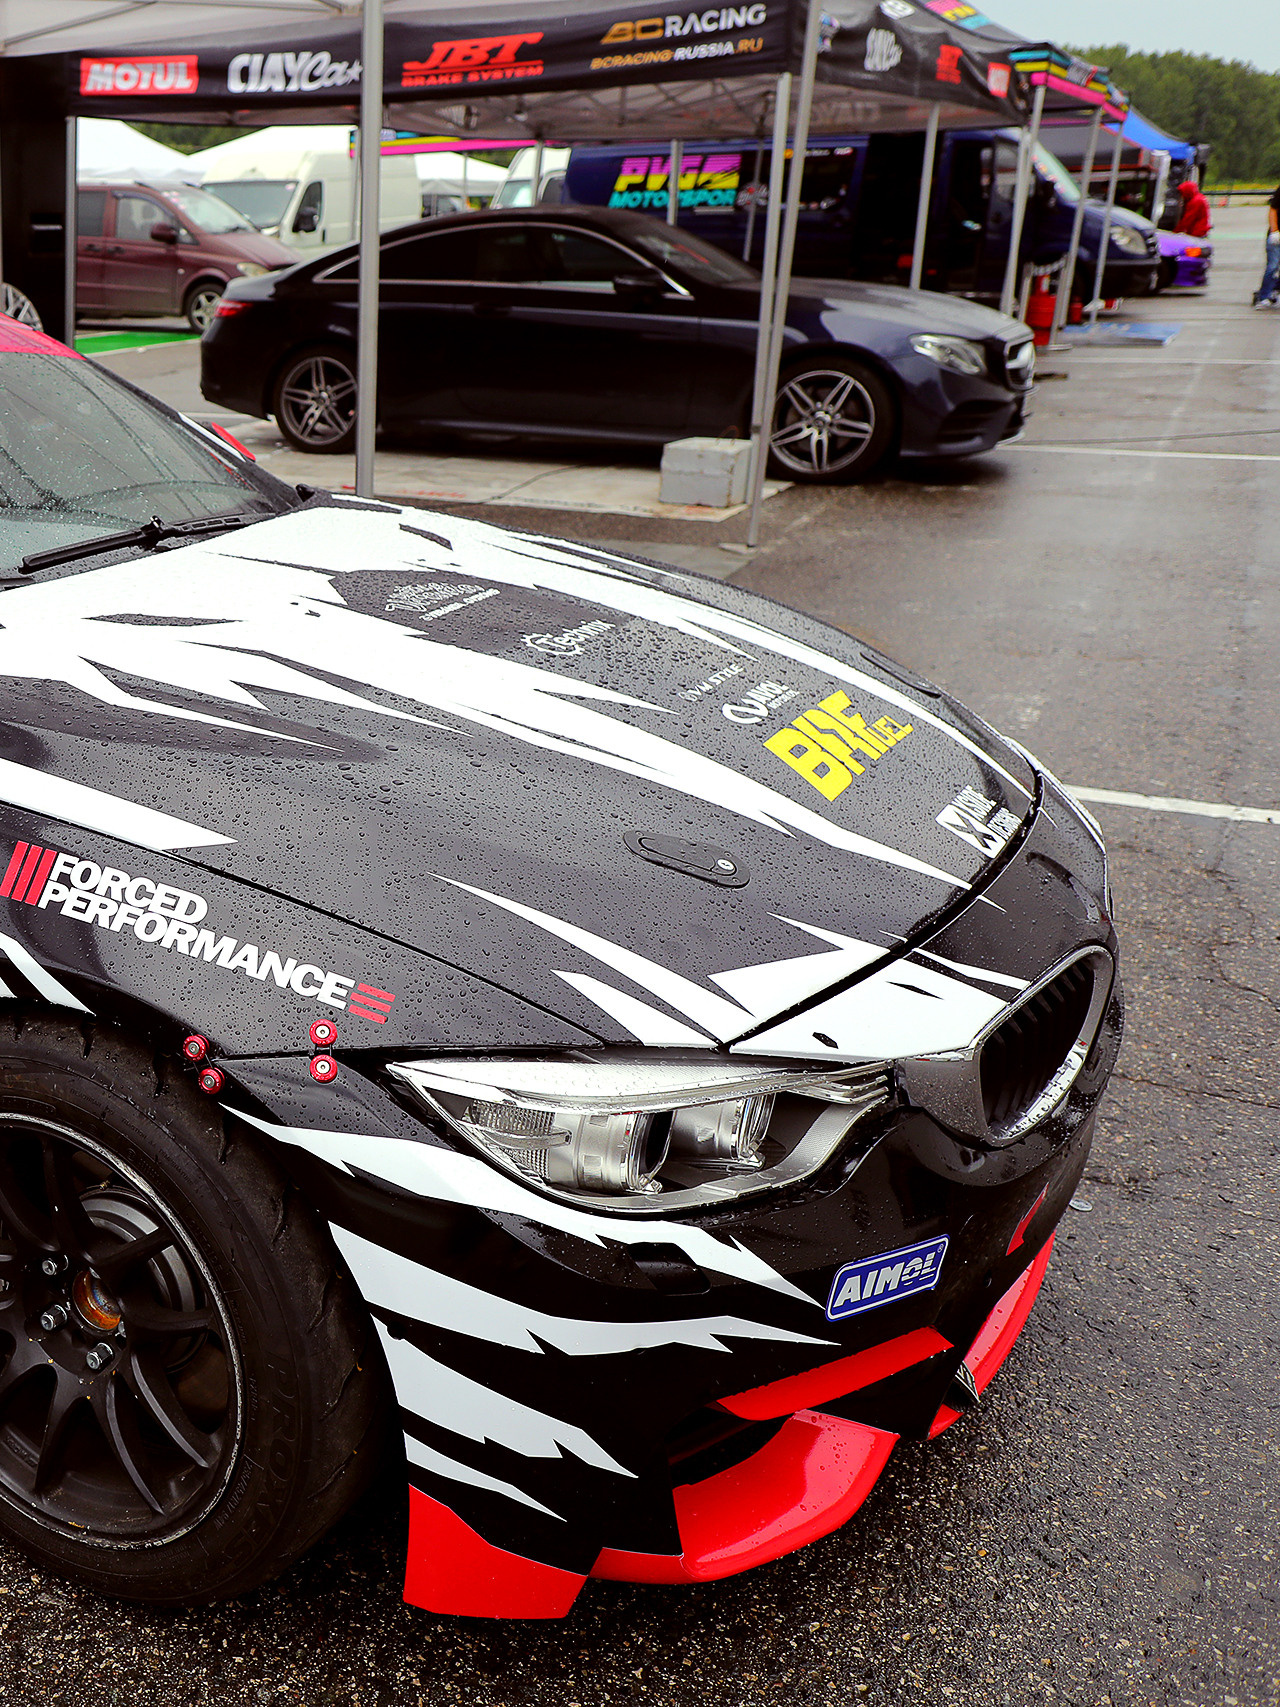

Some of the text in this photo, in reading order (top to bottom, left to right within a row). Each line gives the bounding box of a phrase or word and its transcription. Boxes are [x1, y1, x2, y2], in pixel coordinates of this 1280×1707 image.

[402, 32, 544, 70] JBT
[85, 62, 194, 91] MOTUL
[401, 66, 544, 87] BRAKE SYSTEM
[49, 852, 208, 925] FORCED
[38, 880, 355, 1011] PERFORMANCE
[833, 1251, 937, 1308] AIMOL
